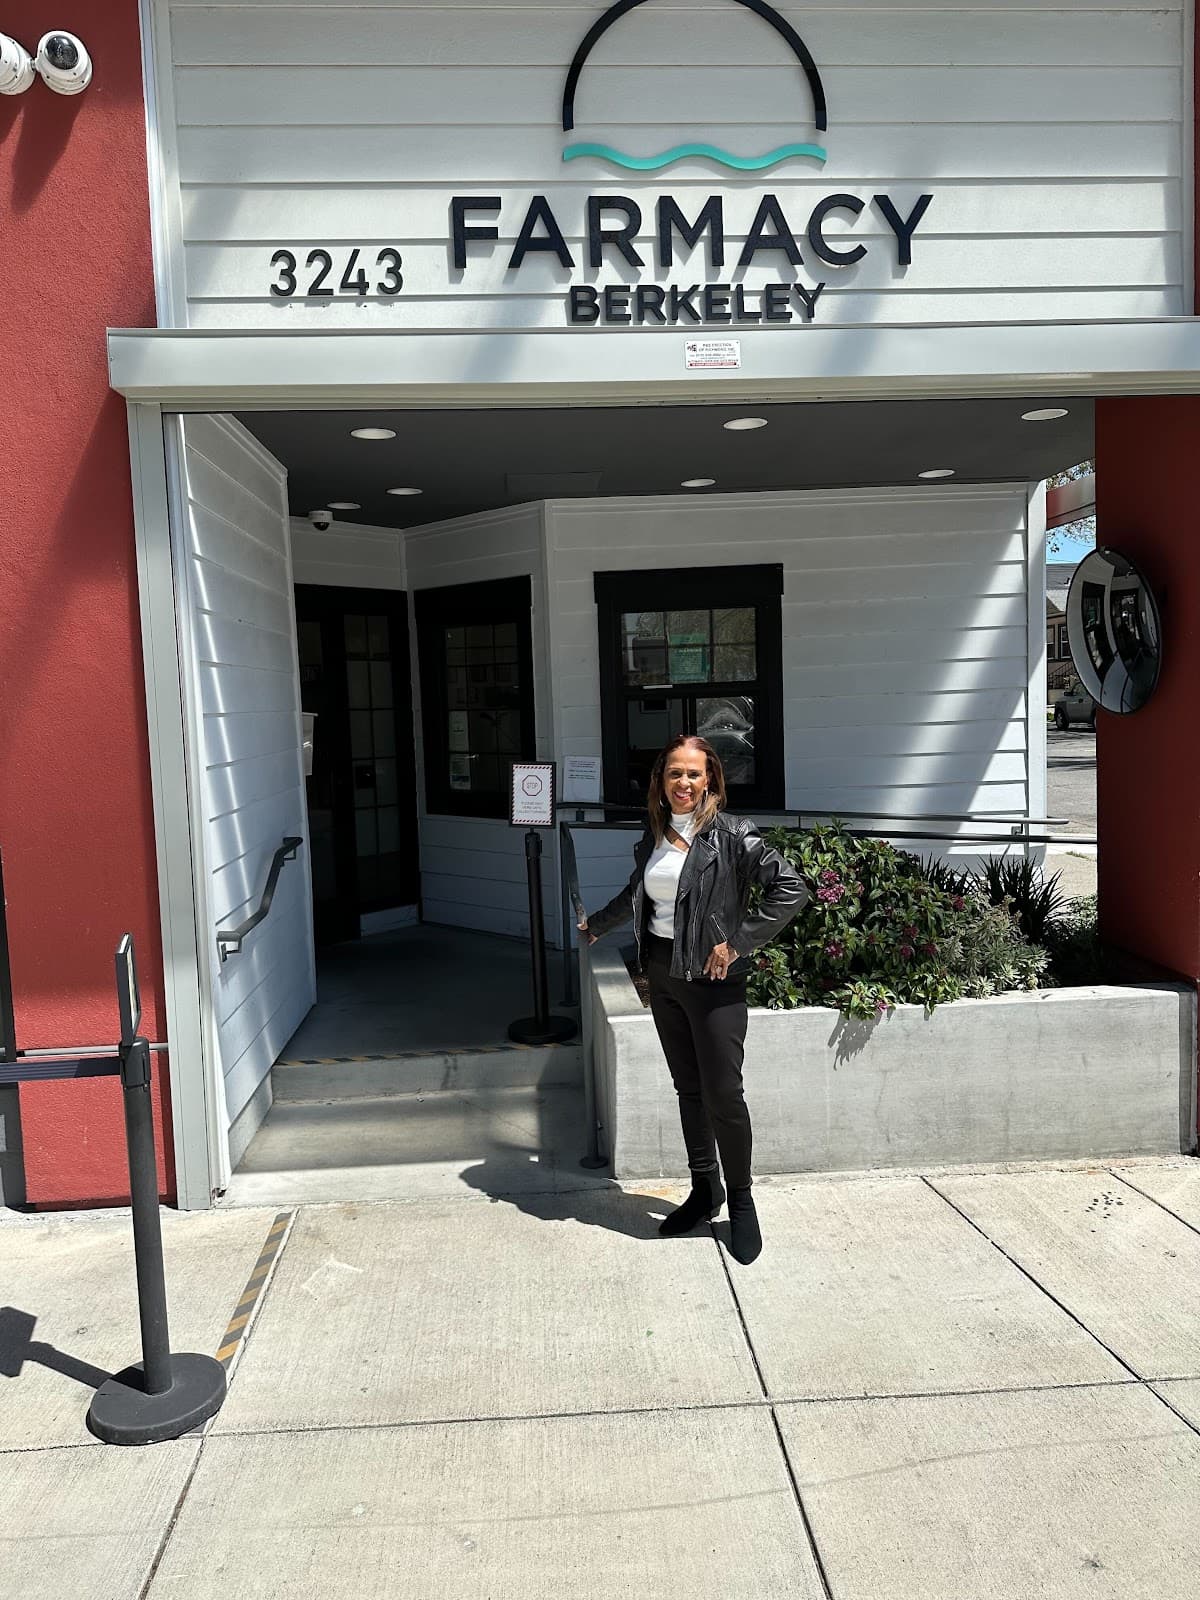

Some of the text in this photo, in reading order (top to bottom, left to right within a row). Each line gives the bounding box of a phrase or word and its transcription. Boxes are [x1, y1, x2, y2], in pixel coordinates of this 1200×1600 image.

[452, 194, 934, 268] FARMACY
[270, 248, 404, 296] 3243
[569, 283, 826, 322] BERKELEY
